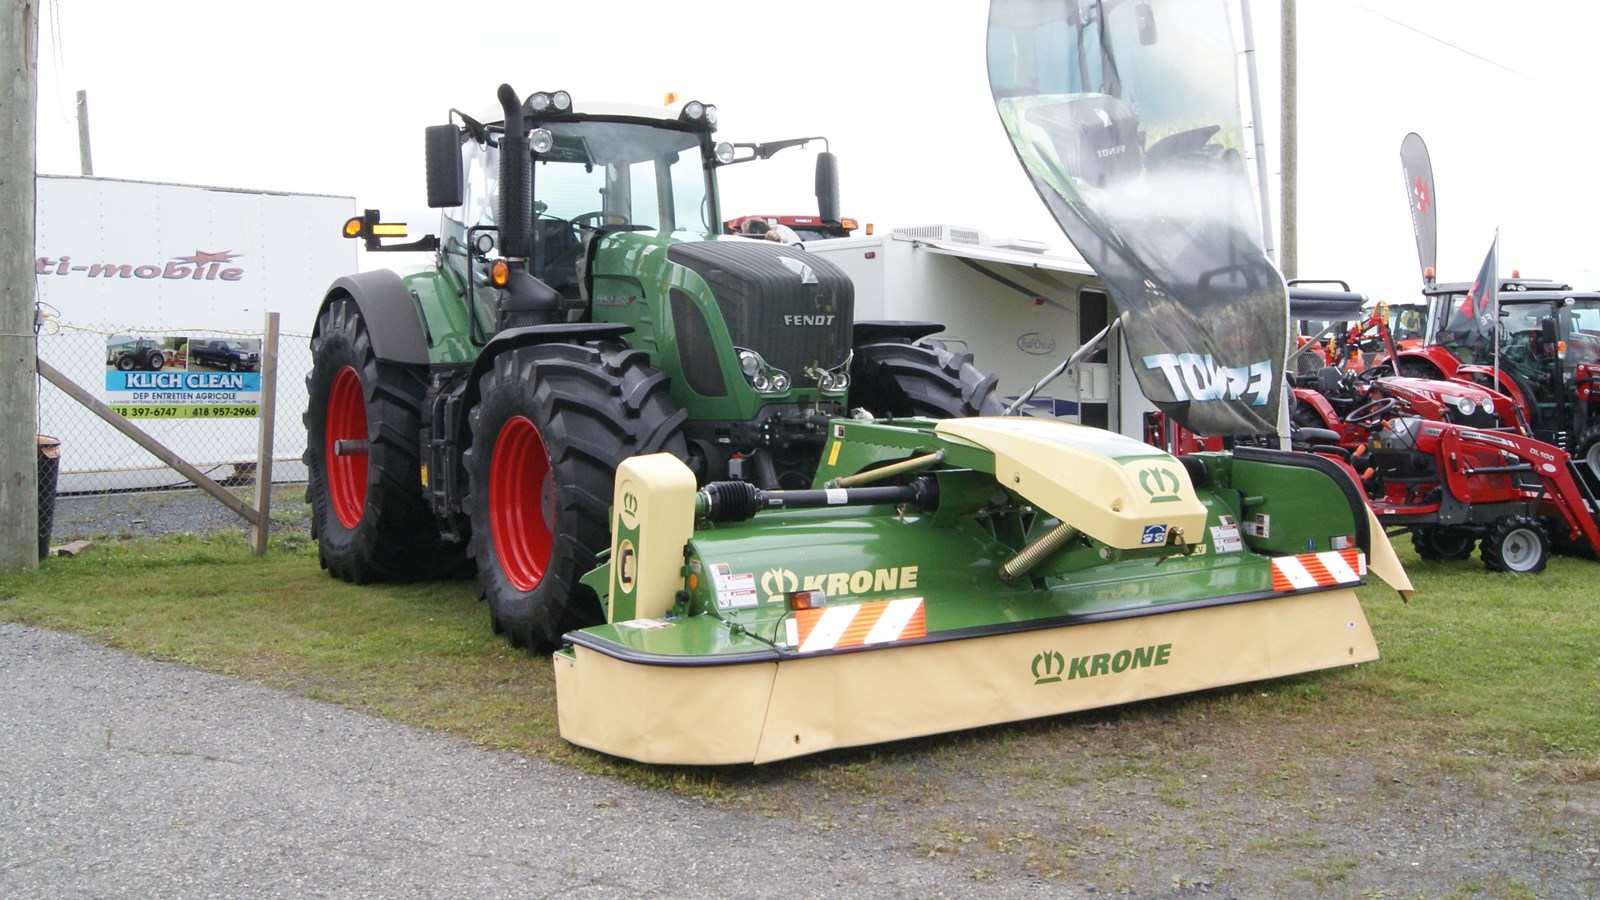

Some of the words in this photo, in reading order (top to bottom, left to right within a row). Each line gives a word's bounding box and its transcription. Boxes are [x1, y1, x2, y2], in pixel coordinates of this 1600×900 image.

[783, 314, 836, 326] FENDT
[126, 373, 182, 389] KLICH
[184, 373, 243, 390] CLEAN
[133, 392, 149, 400] DEP
[152, 392, 194, 400] ENTRETIEN
[195, 392, 237, 400] AGRICOLE
[113, 407, 128, 418] 18
[131, 407, 177, 417] 397-6747
[192, 407, 209, 417] 418
[212, 407, 256, 417] 957-2966
[803, 565, 919, 597] KRONE
[1067, 642, 1173, 681] KRONE
